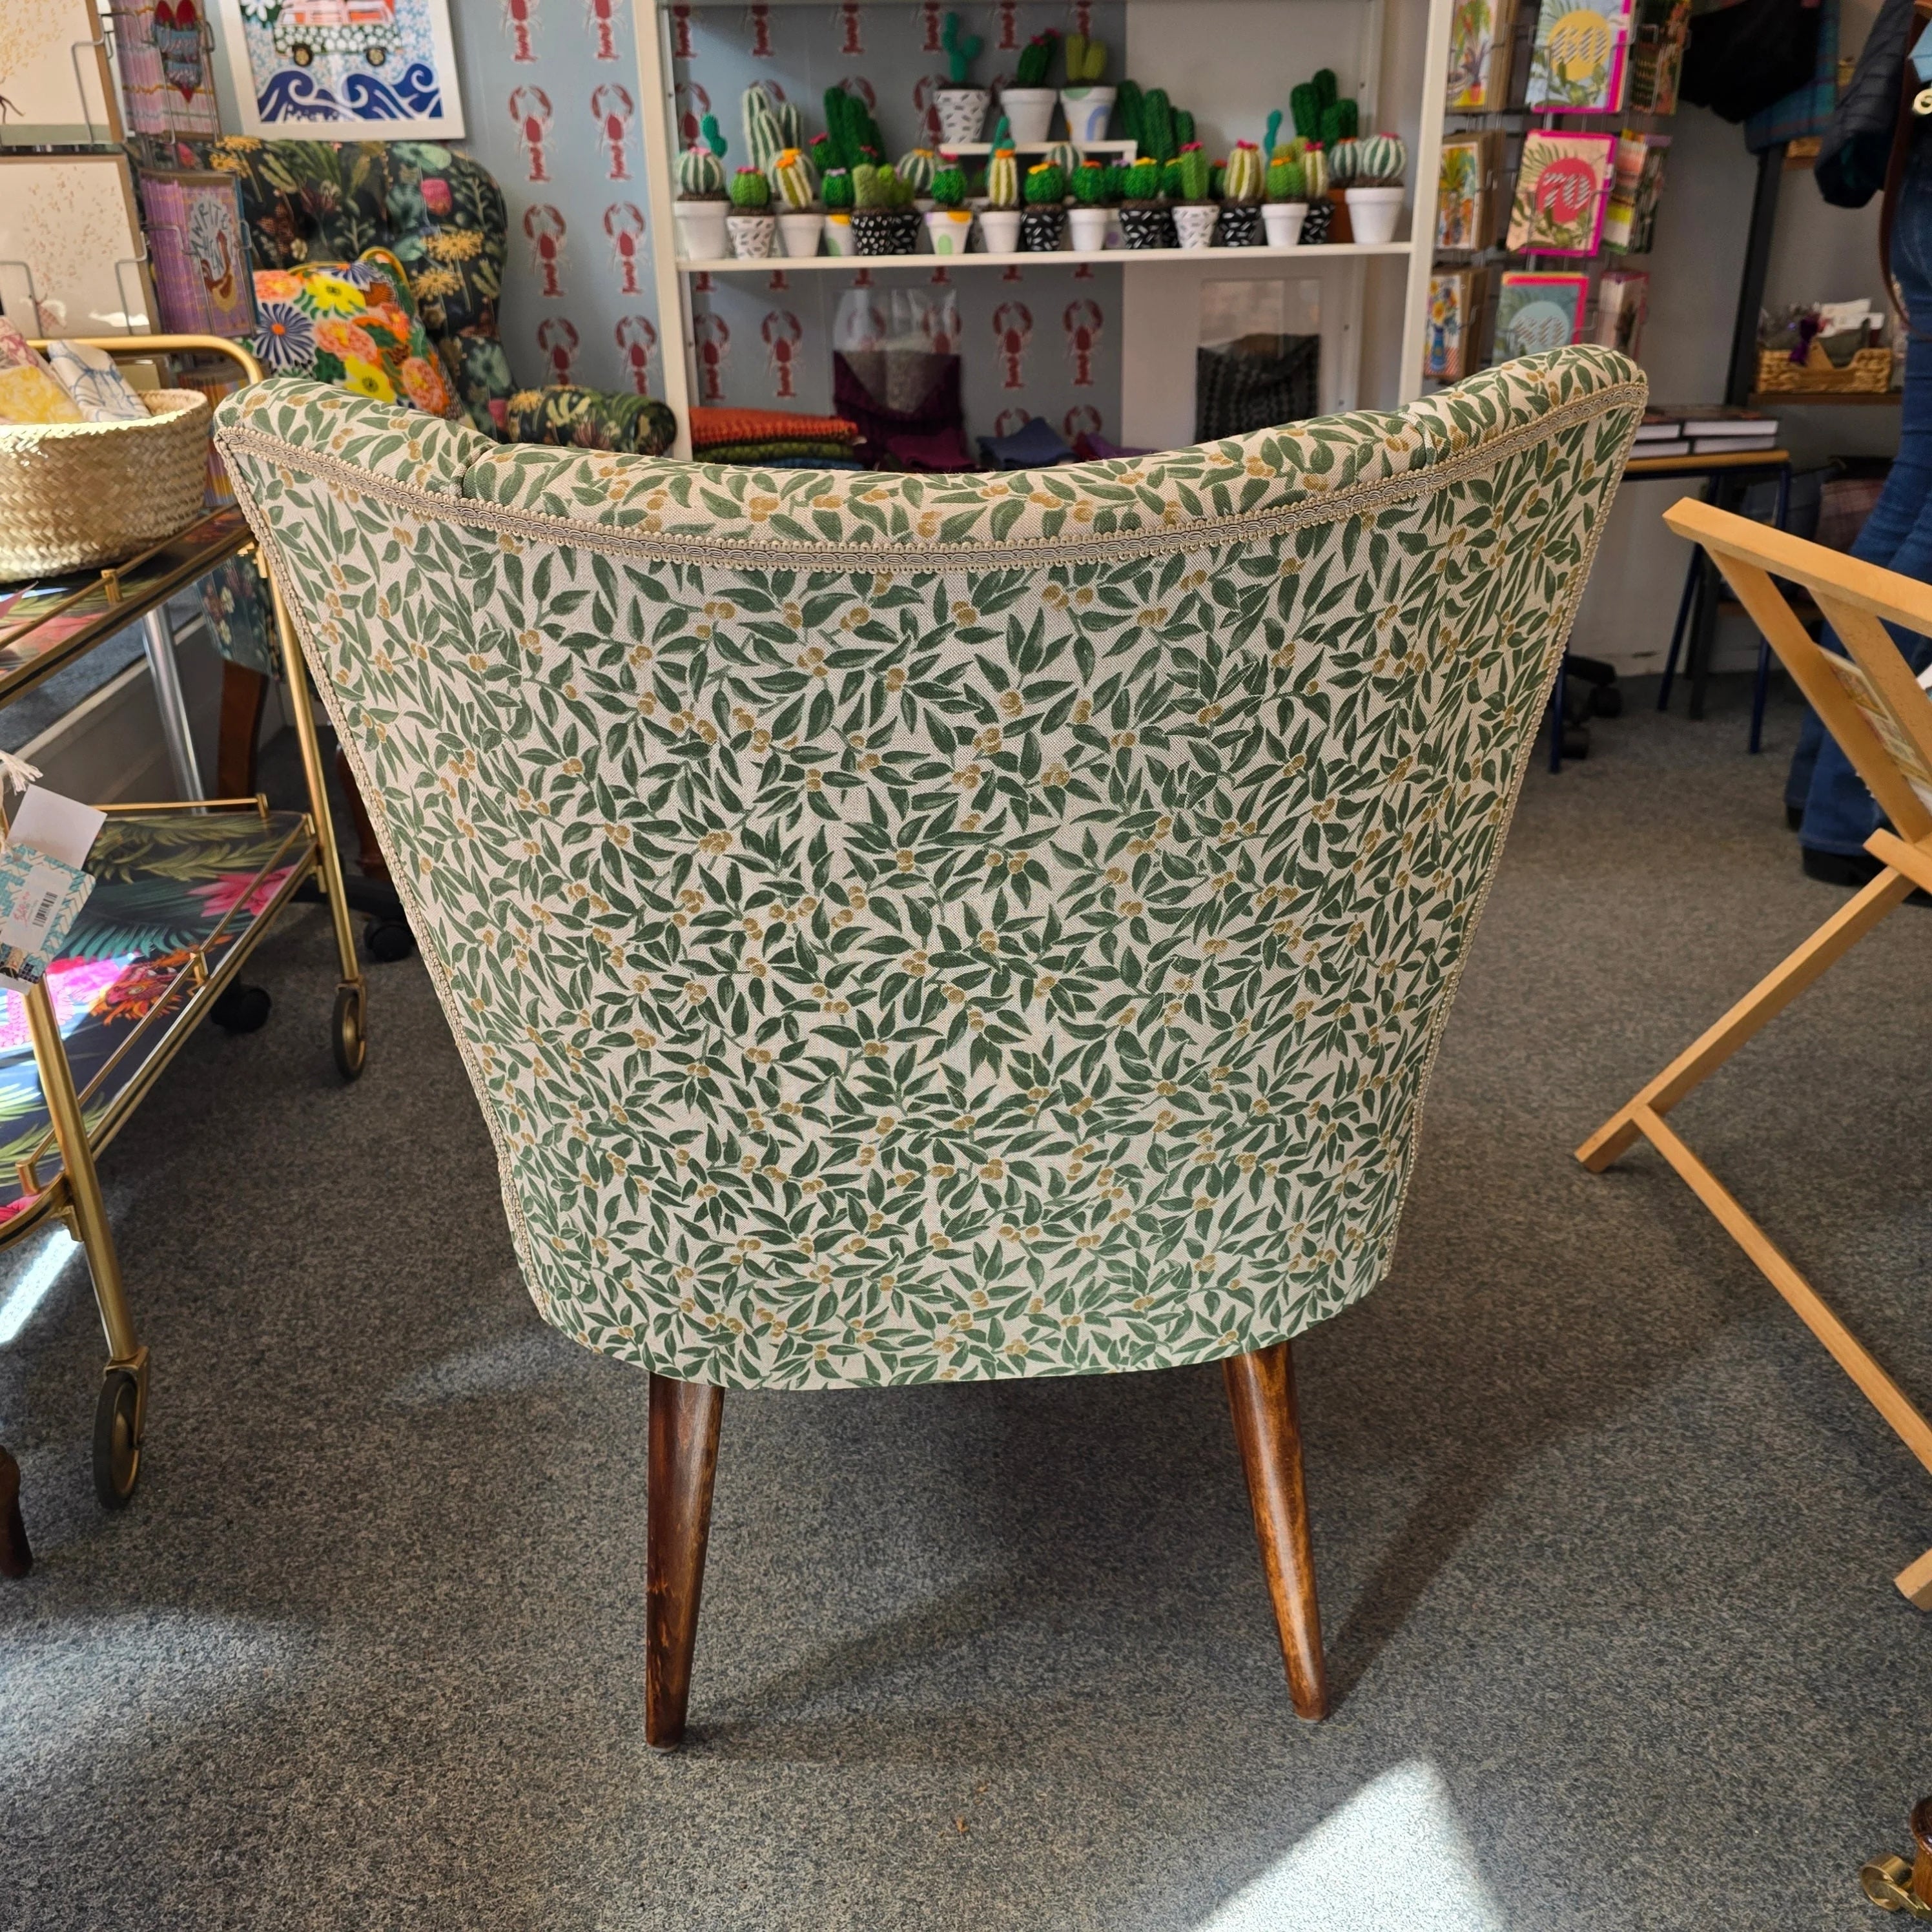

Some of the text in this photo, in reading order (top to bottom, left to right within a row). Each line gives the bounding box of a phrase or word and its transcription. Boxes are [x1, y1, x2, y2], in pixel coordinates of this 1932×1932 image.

[1550, 26, 1607, 64] 60
[1542, 172, 1591, 210] 70
[192, 200, 228, 238] WRITE
